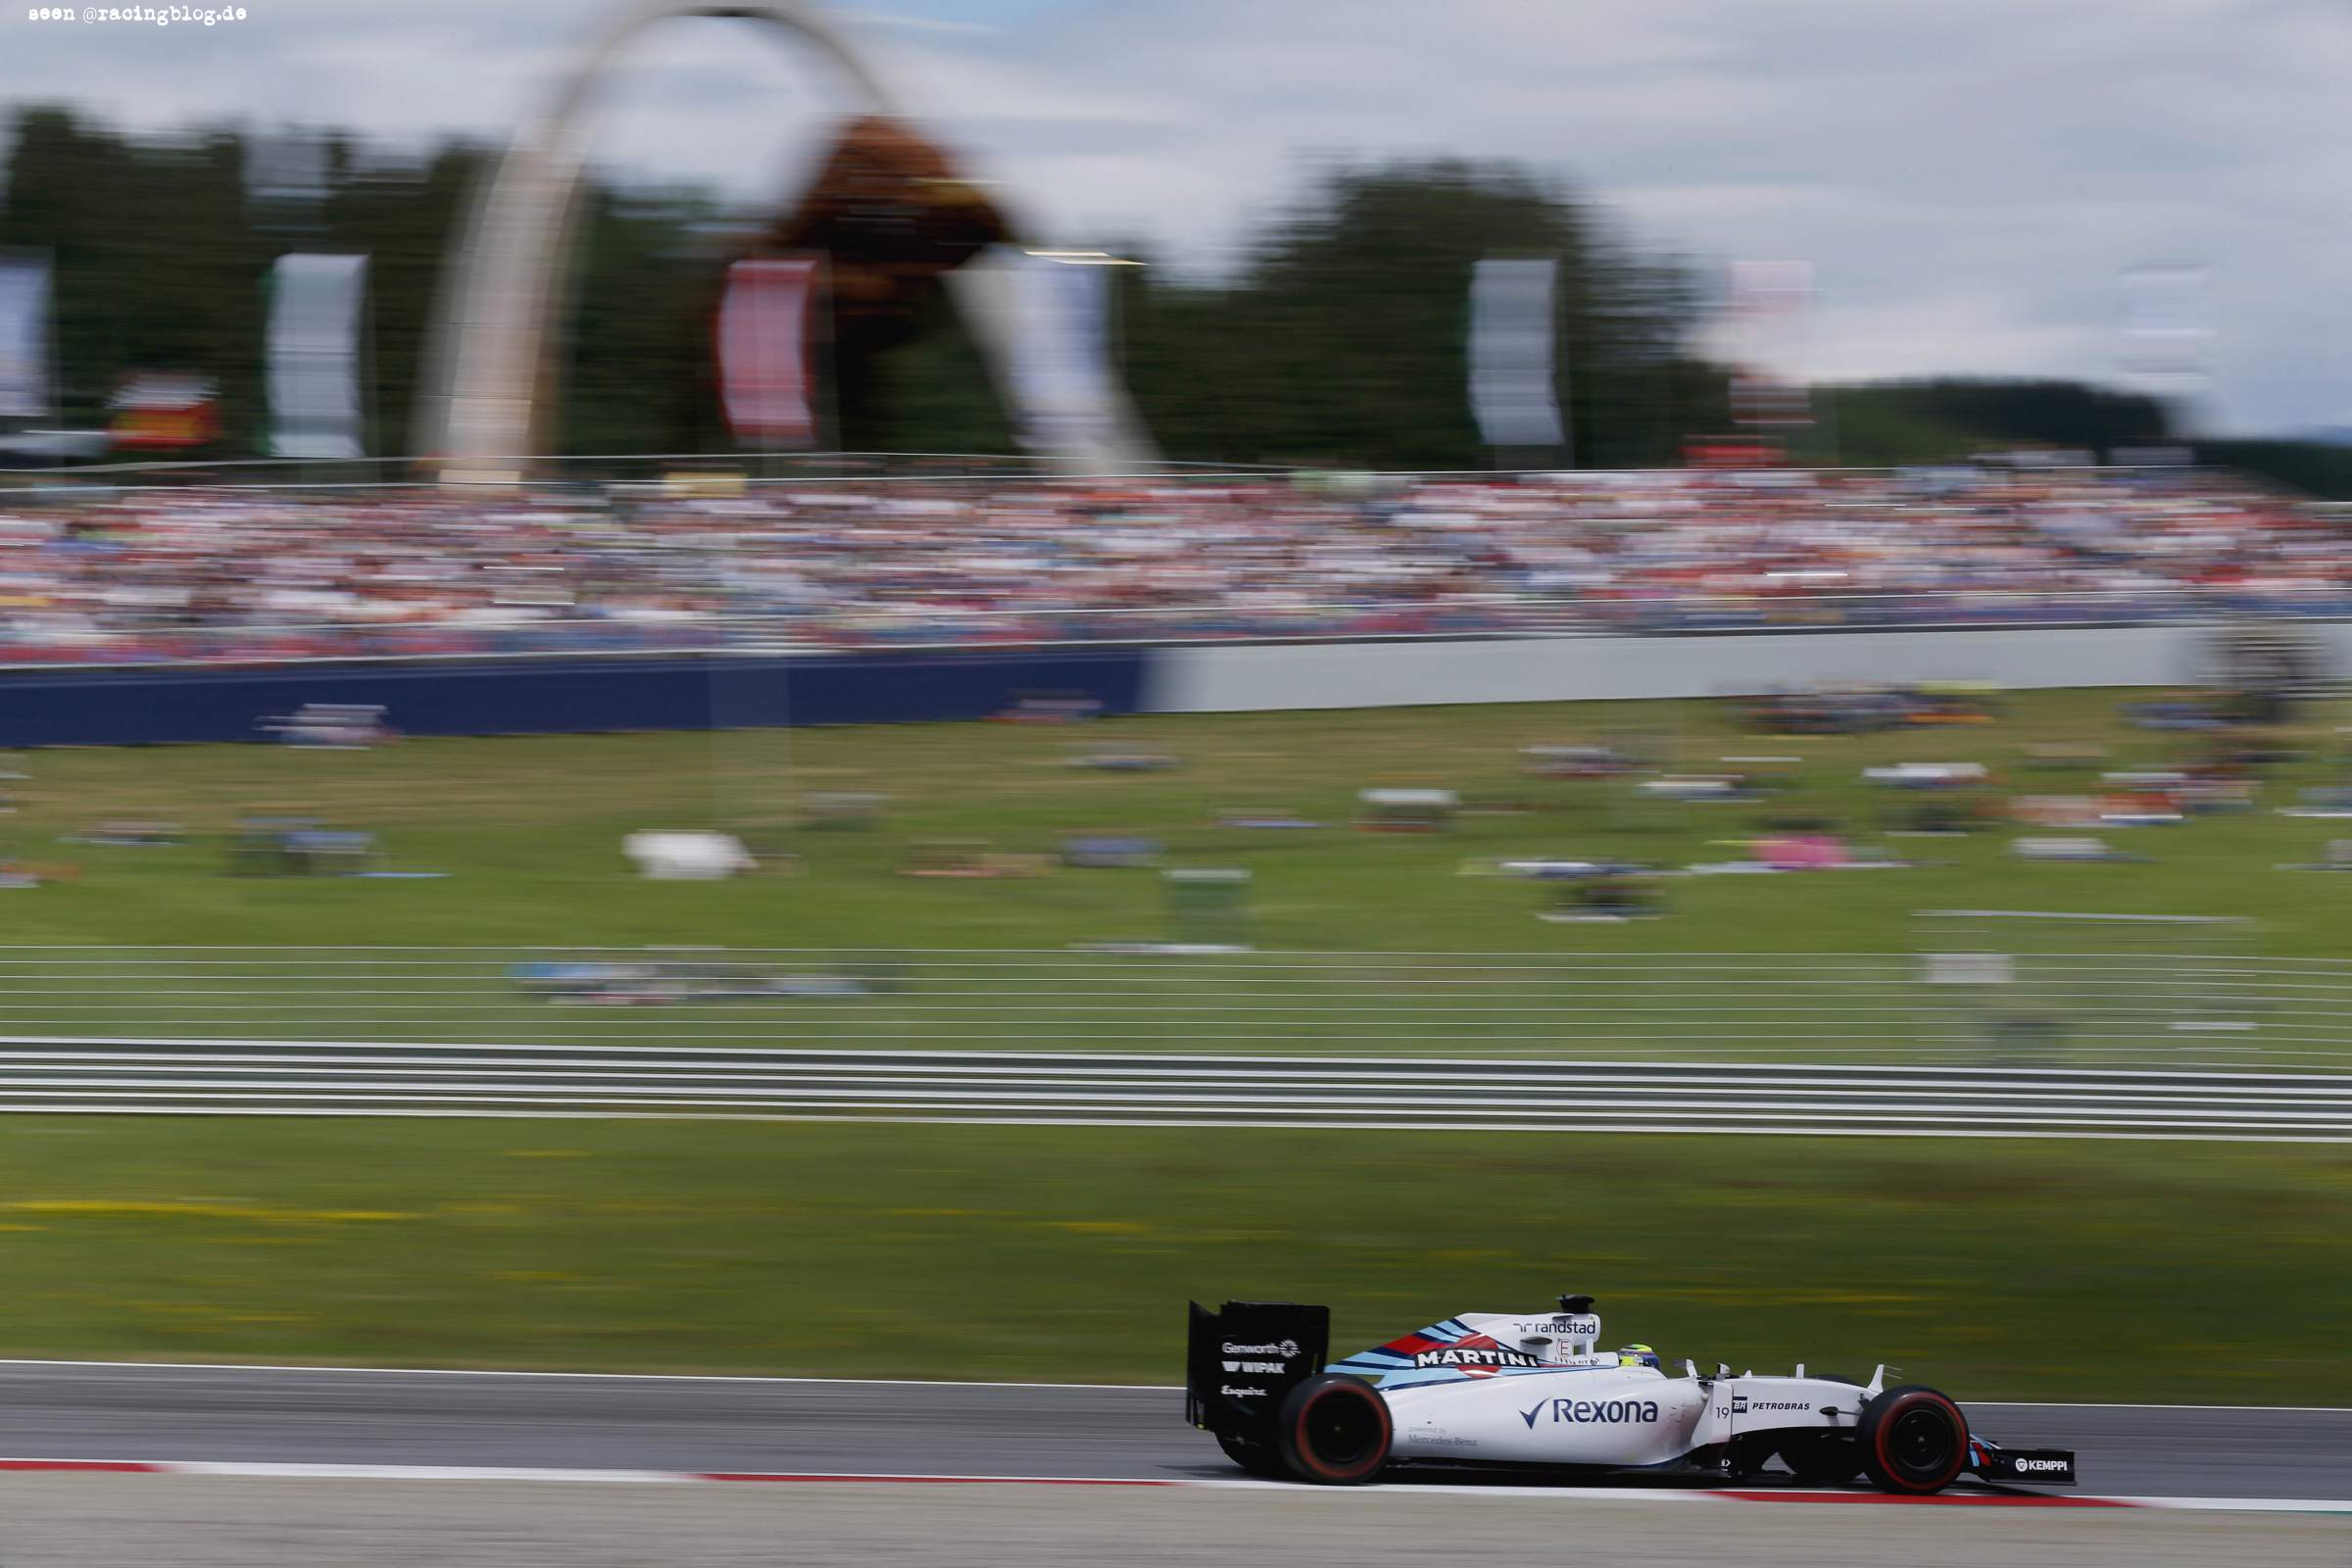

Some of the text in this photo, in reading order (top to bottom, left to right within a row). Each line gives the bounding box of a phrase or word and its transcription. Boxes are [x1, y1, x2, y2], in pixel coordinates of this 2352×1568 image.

[1535, 1321, 1595, 1334] randstad
[1222, 1342, 1279, 1354] Genworth
[1417, 1348, 1538, 1368] MARTINI
[1553, 1398, 1658, 1423] Rexona
[1716, 1406, 1730, 1419] 19
[2029, 1460, 2068, 1471] KEMPPI
